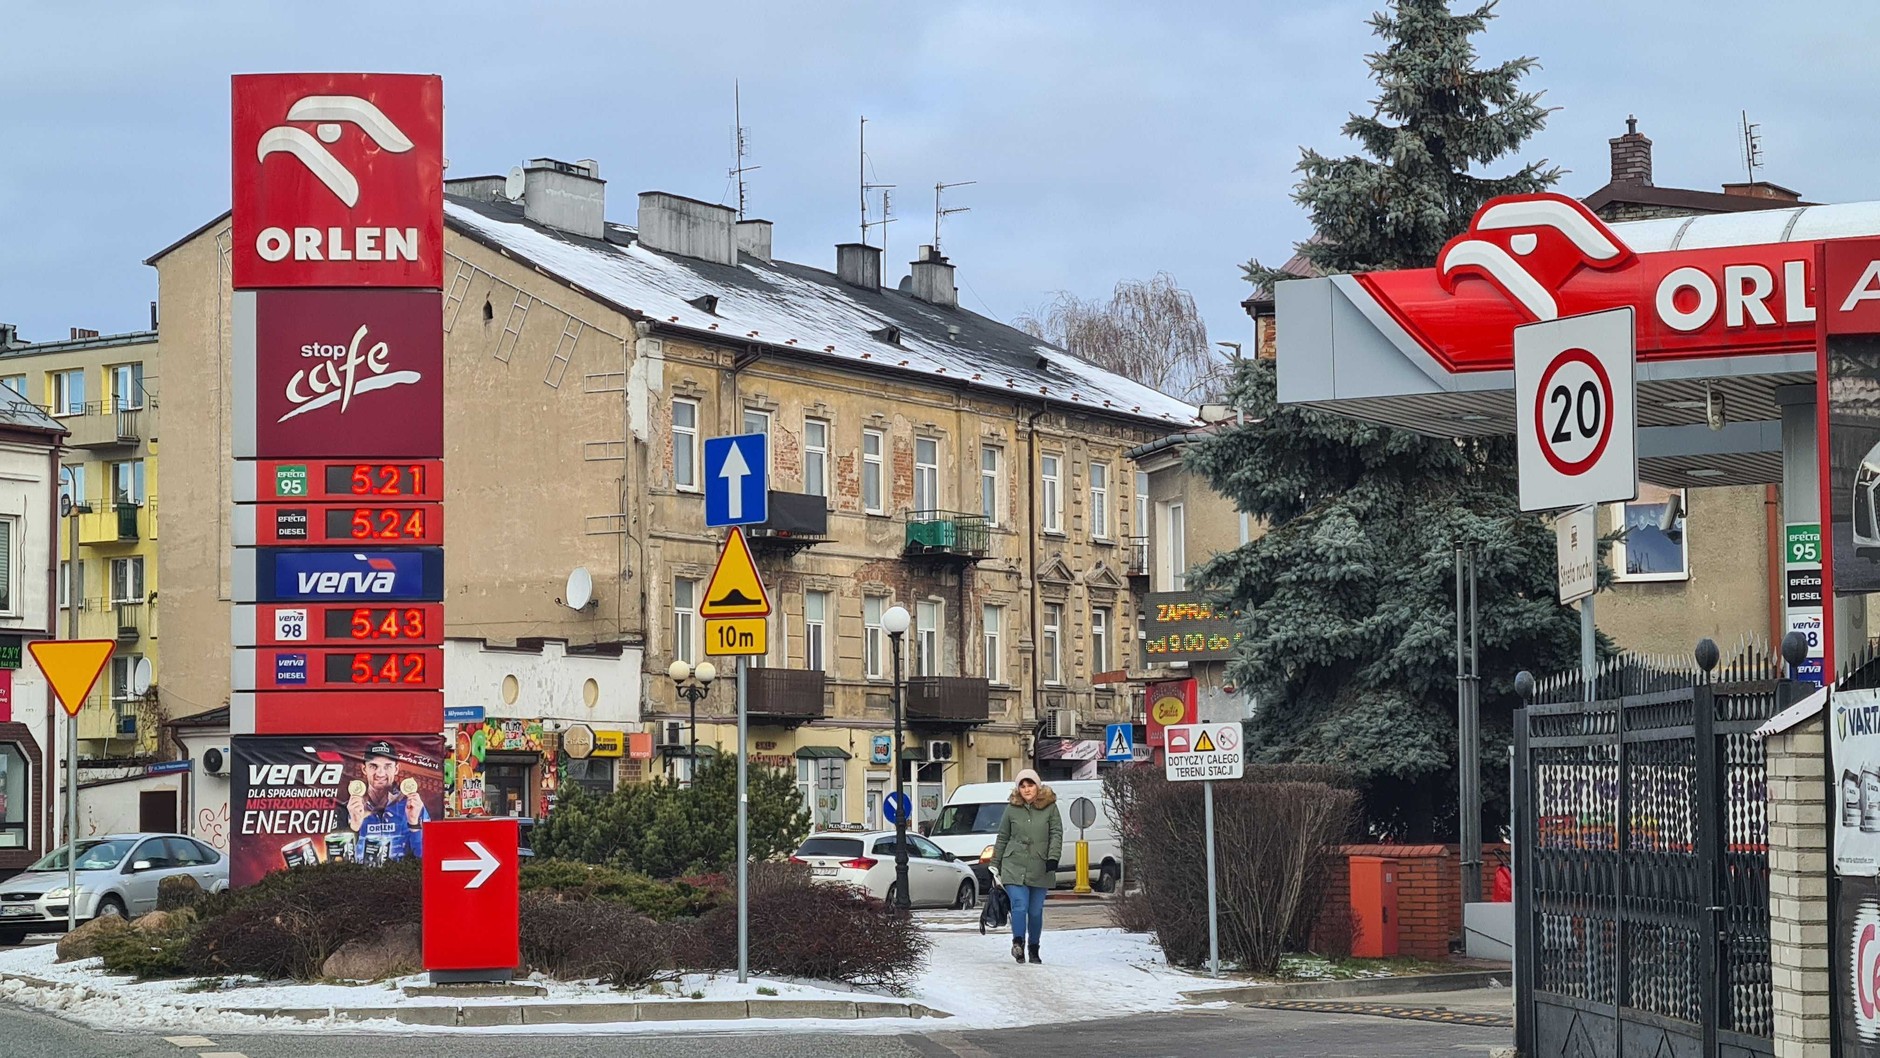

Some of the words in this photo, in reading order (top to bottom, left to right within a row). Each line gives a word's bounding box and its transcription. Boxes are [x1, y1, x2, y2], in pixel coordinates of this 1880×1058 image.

[256, 227, 418, 262] ORLEN
[1656, 260, 1817, 332] ORL
[300, 342, 346, 360] stop
[286, 324, 390, 414] cafe
[1551, 381, 1600, 444] 20
[277, 469, 306, 478] efecta
[351, 464, 423, 495] 5.21
[281, 480, 302, 494] 95
[278, 513, 306, 523] efecta
[351, 508, 423, 539] 5.24
[1789, 531, 1820, 542] efecta
[1793, 543, 1817, 561] 95
[1560, 564, 1576, 588] Strefa
[1577, 556, 1593, 581] ruchu
[1790, 575, 1821, 586] efecta
[298, 571, 396, 594] verva
[1791, 592, 1821, 601] DIESEL
[278, 613, 304, 622] verva
[1156, 602, 1213, 622] ZAPRA
[281, 624, 302, 638] 98
[351, 608, 423, 639] 5.43
[1792, 621, 1821, 630] verva
[718, 625, 737, 648] 10
[739, 632, 754, 647] m
[1146, 635, 1168, 656] od
[1169, 632, 1206, 653] 9.00
[1207, 633, 1231, 652] do
[1802, 631, 1819, 648] 8
[0, 646, 20, 659] ZNY
[278, 658, 304, 667] verva
[351, 653, 423, 683] 5.42
[1168, 755, 1205, 766] DOTYCZY
[1207, 753, 1240, 765] CAŁEGO
[248, 763, 344, 786] verva
[1176, 766, 1206, 777] TERENU
[1208, 765, 1234, 776] STACJI
[248, 789, 267, 798] DLA
[267, 788, 338, 798] SPRAGNIONYCH
[245, 798, 336, 810] MISTRZOWSKIEJ
[241, 810, 334, 835] ENERGII
[368, 824, 394, 832] ORLEN
